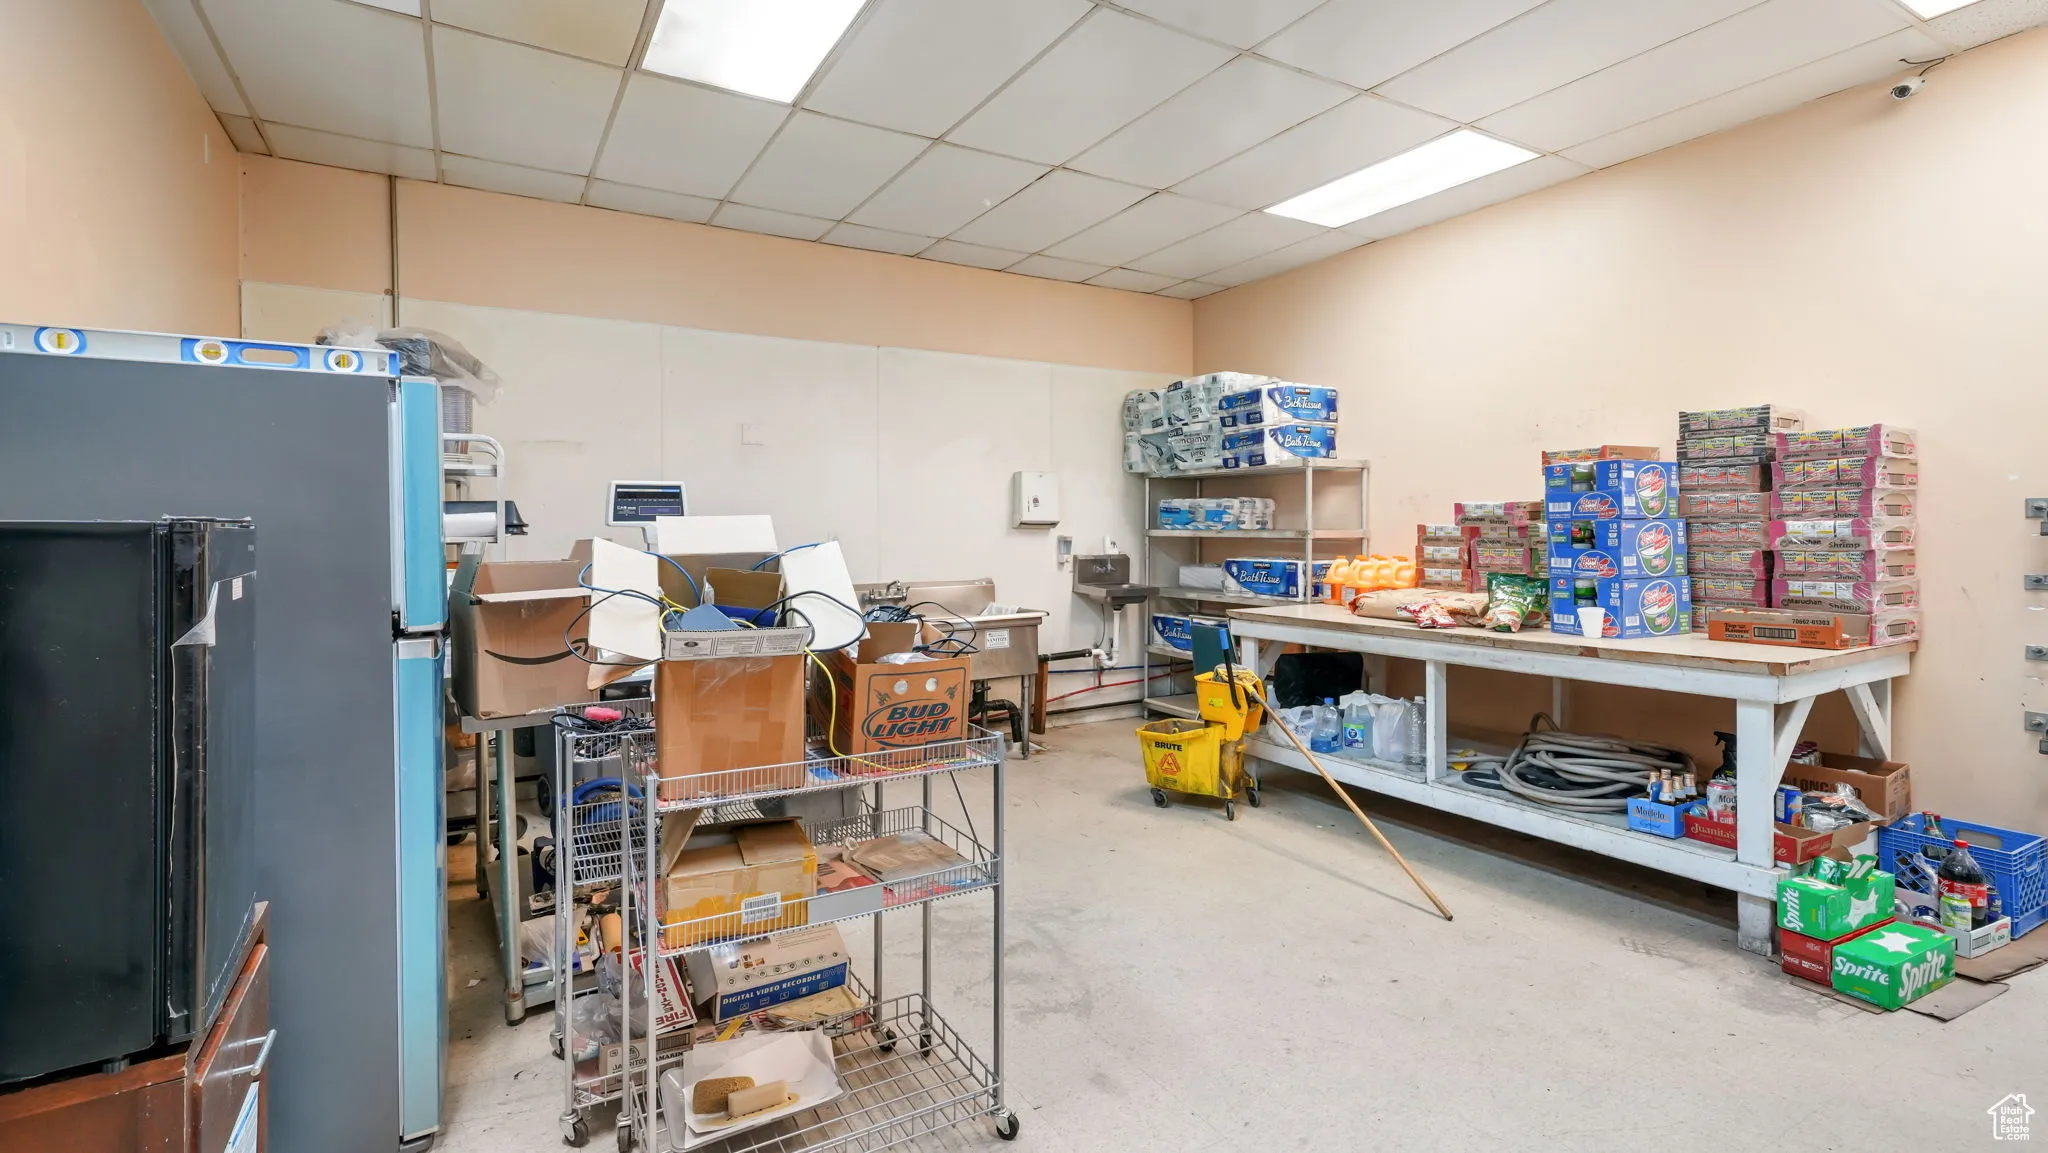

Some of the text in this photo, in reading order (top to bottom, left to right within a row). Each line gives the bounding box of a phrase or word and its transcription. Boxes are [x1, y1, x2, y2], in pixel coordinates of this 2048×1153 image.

[1284, 434, 1302, 447] Bath
[1828, 542, 1861, 550] Shrimp
[1240, 570, 1281, 584] Bath Tissue
[887, 702, 950, 722] BUD
[870, 716, 958, 741] LIGHT
[1154, 741, 1183, 752] BRUTE
[1634, 805, 1666, 820] Modelo
[1690, 821, 1736, 840] Juanita's
[1782, 887, 1804, 932] Sprite
[1834, 955, 1890, 986] Sprite
[1897, 950, 1947, 1001] Sprite
[722, 989, 755, 1005] DIGITAL
[756, 984, 780, 997] VIDEO
[782, 973, 822, 989] RECORDER
[656, 1009, 689, 1026] FIRE
